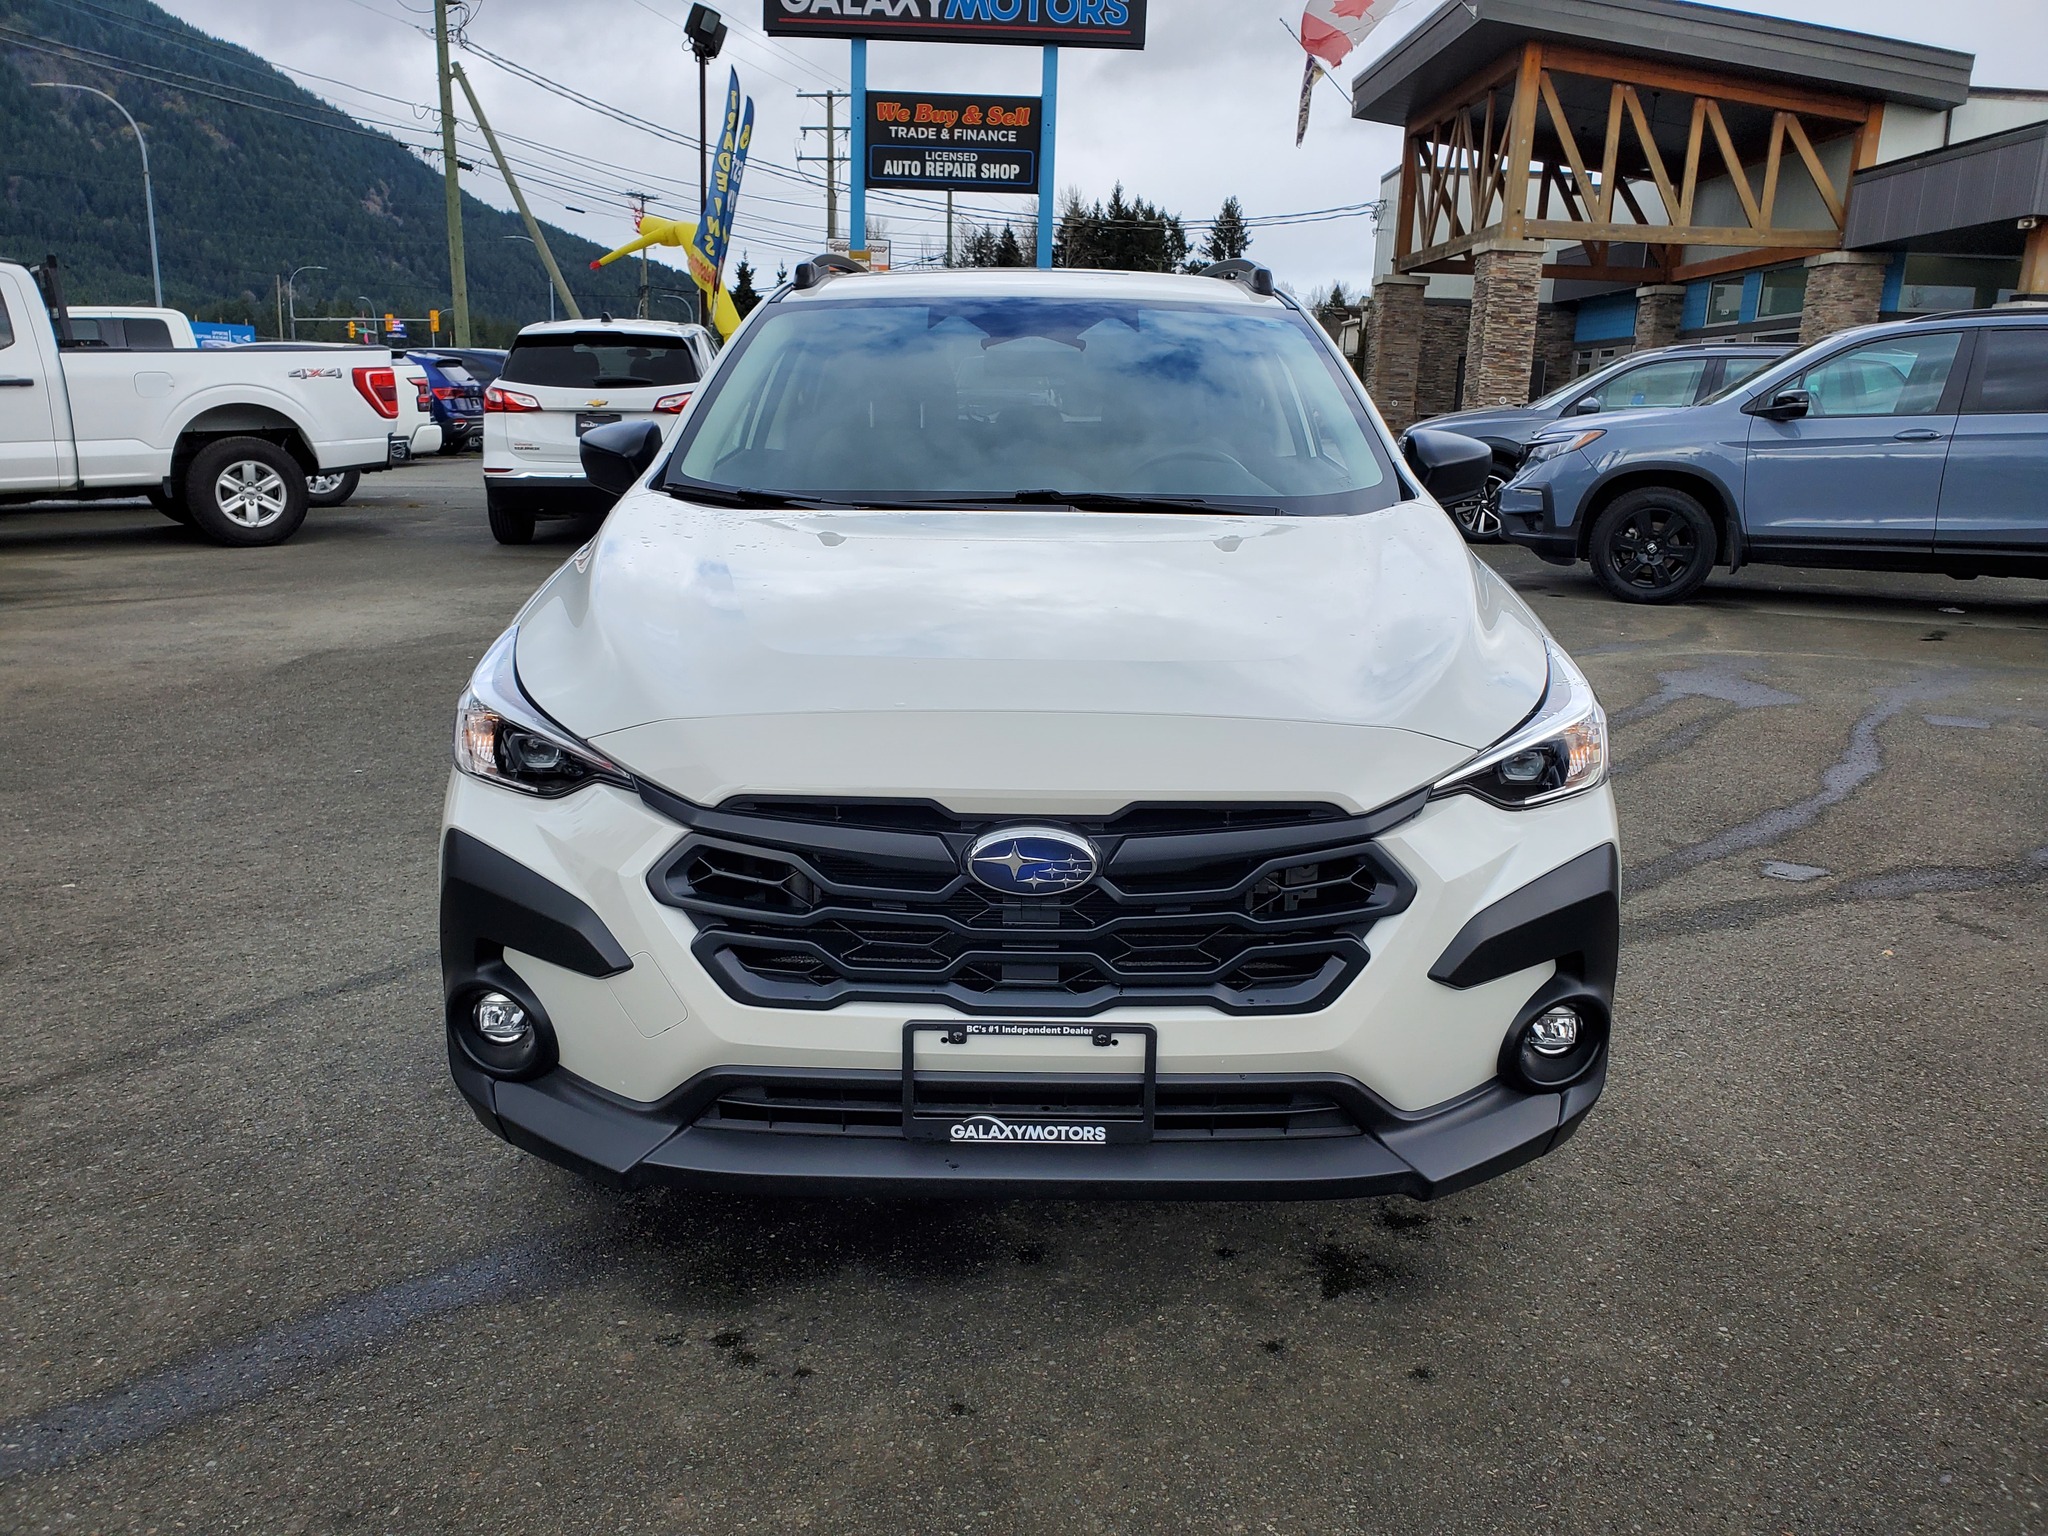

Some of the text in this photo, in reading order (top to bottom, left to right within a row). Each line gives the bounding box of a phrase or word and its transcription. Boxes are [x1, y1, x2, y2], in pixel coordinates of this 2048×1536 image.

[876, 102, 1030, 128] We Buy & Sell
[889, 126, 1017, 142] TRADE & FINANCE
[925, 151, 978, 162] LICENSED
[883, 160, 1020, 180] AUTO REPAIR SHOP
[966, 1025, 1093, 1036] BC's #1 Independent Dealer
